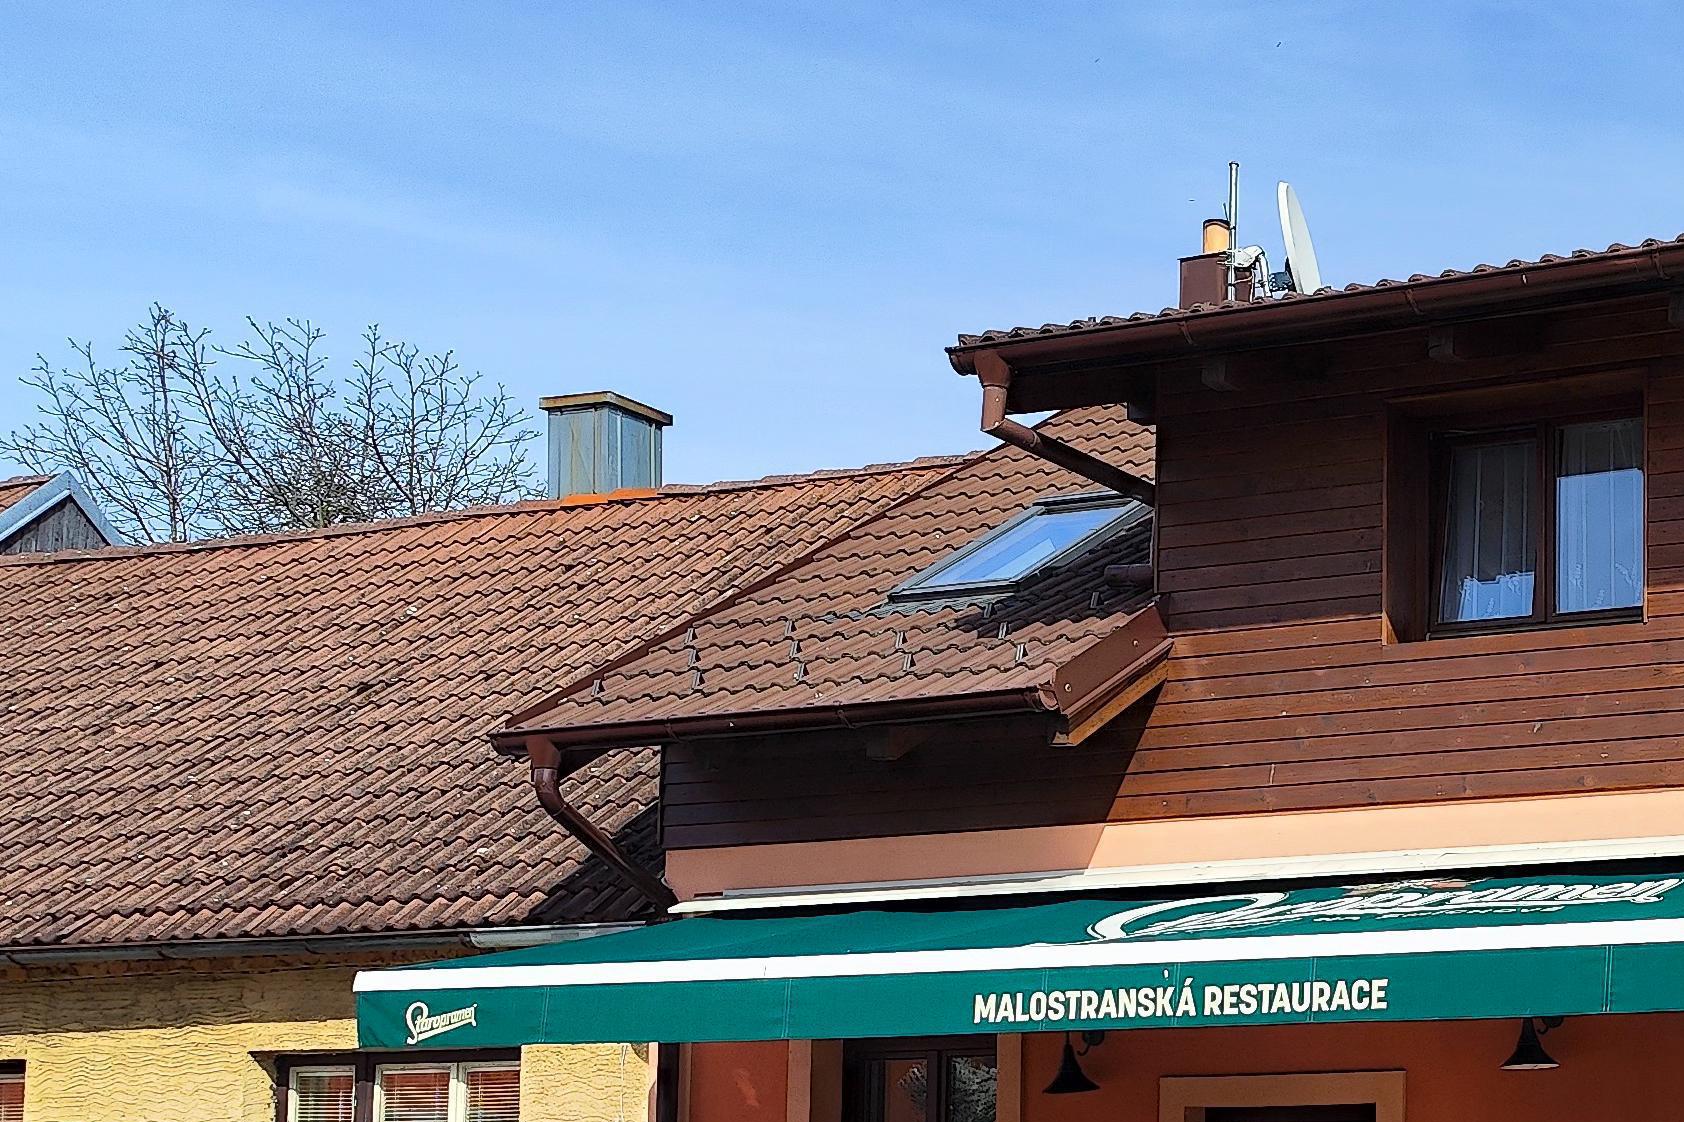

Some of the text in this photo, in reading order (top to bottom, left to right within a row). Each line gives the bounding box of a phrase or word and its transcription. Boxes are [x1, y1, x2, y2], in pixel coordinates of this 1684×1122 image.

[406, 1001, 478, 1045] Staropramen
[973, 977, 1389, 1024] MALOSTRANSKÁ RESTAURACE
